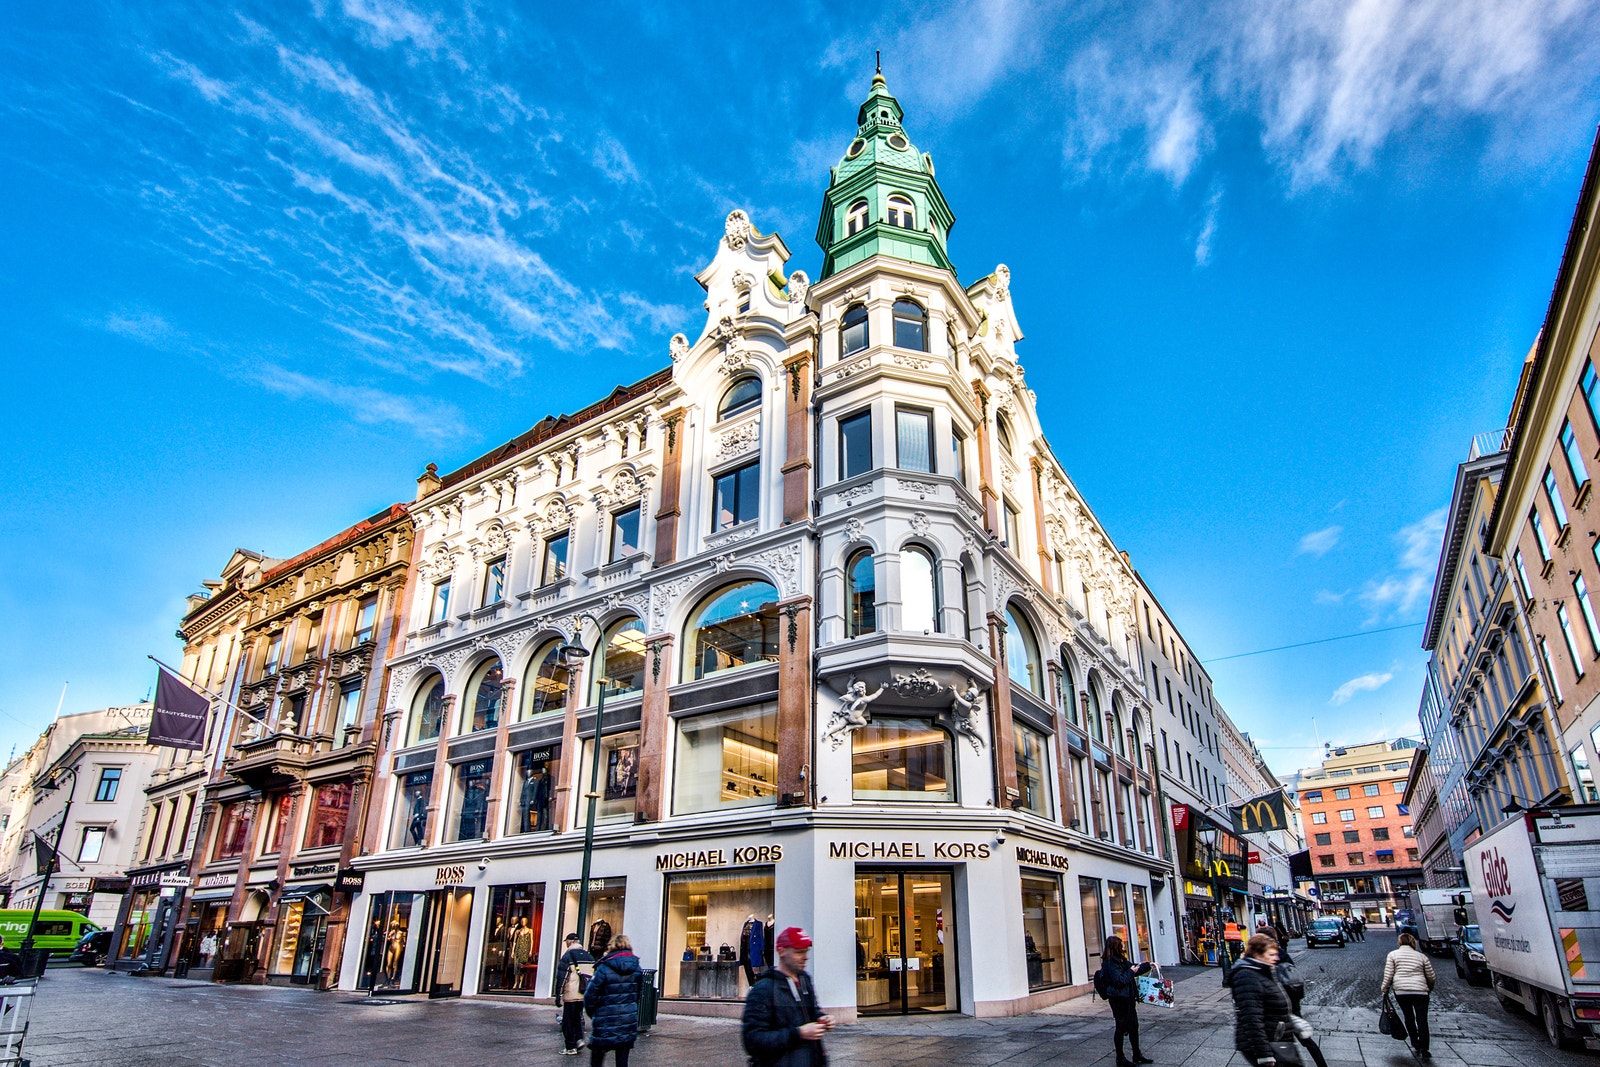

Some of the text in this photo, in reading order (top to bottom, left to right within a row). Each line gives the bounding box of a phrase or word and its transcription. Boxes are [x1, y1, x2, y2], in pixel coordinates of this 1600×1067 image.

[533, 750, 550, 760] BOSS
[470, 763, 485, 771] BOSS
[413, 774, 427, 783] BOSS
[828, 841, 991, 859] MICHAEL KORS
[656, 844, 783, 871] MICHAEL KORS
[1015, 846, 1069, 871] MICHAEL KORS
[436, 865, 465, 880] BOSS
[1480, 846, 1512, 899] Gilde
[342, 876, 362, 884] BOSS
[1562, 890, 1584, 902] ZEPRO
